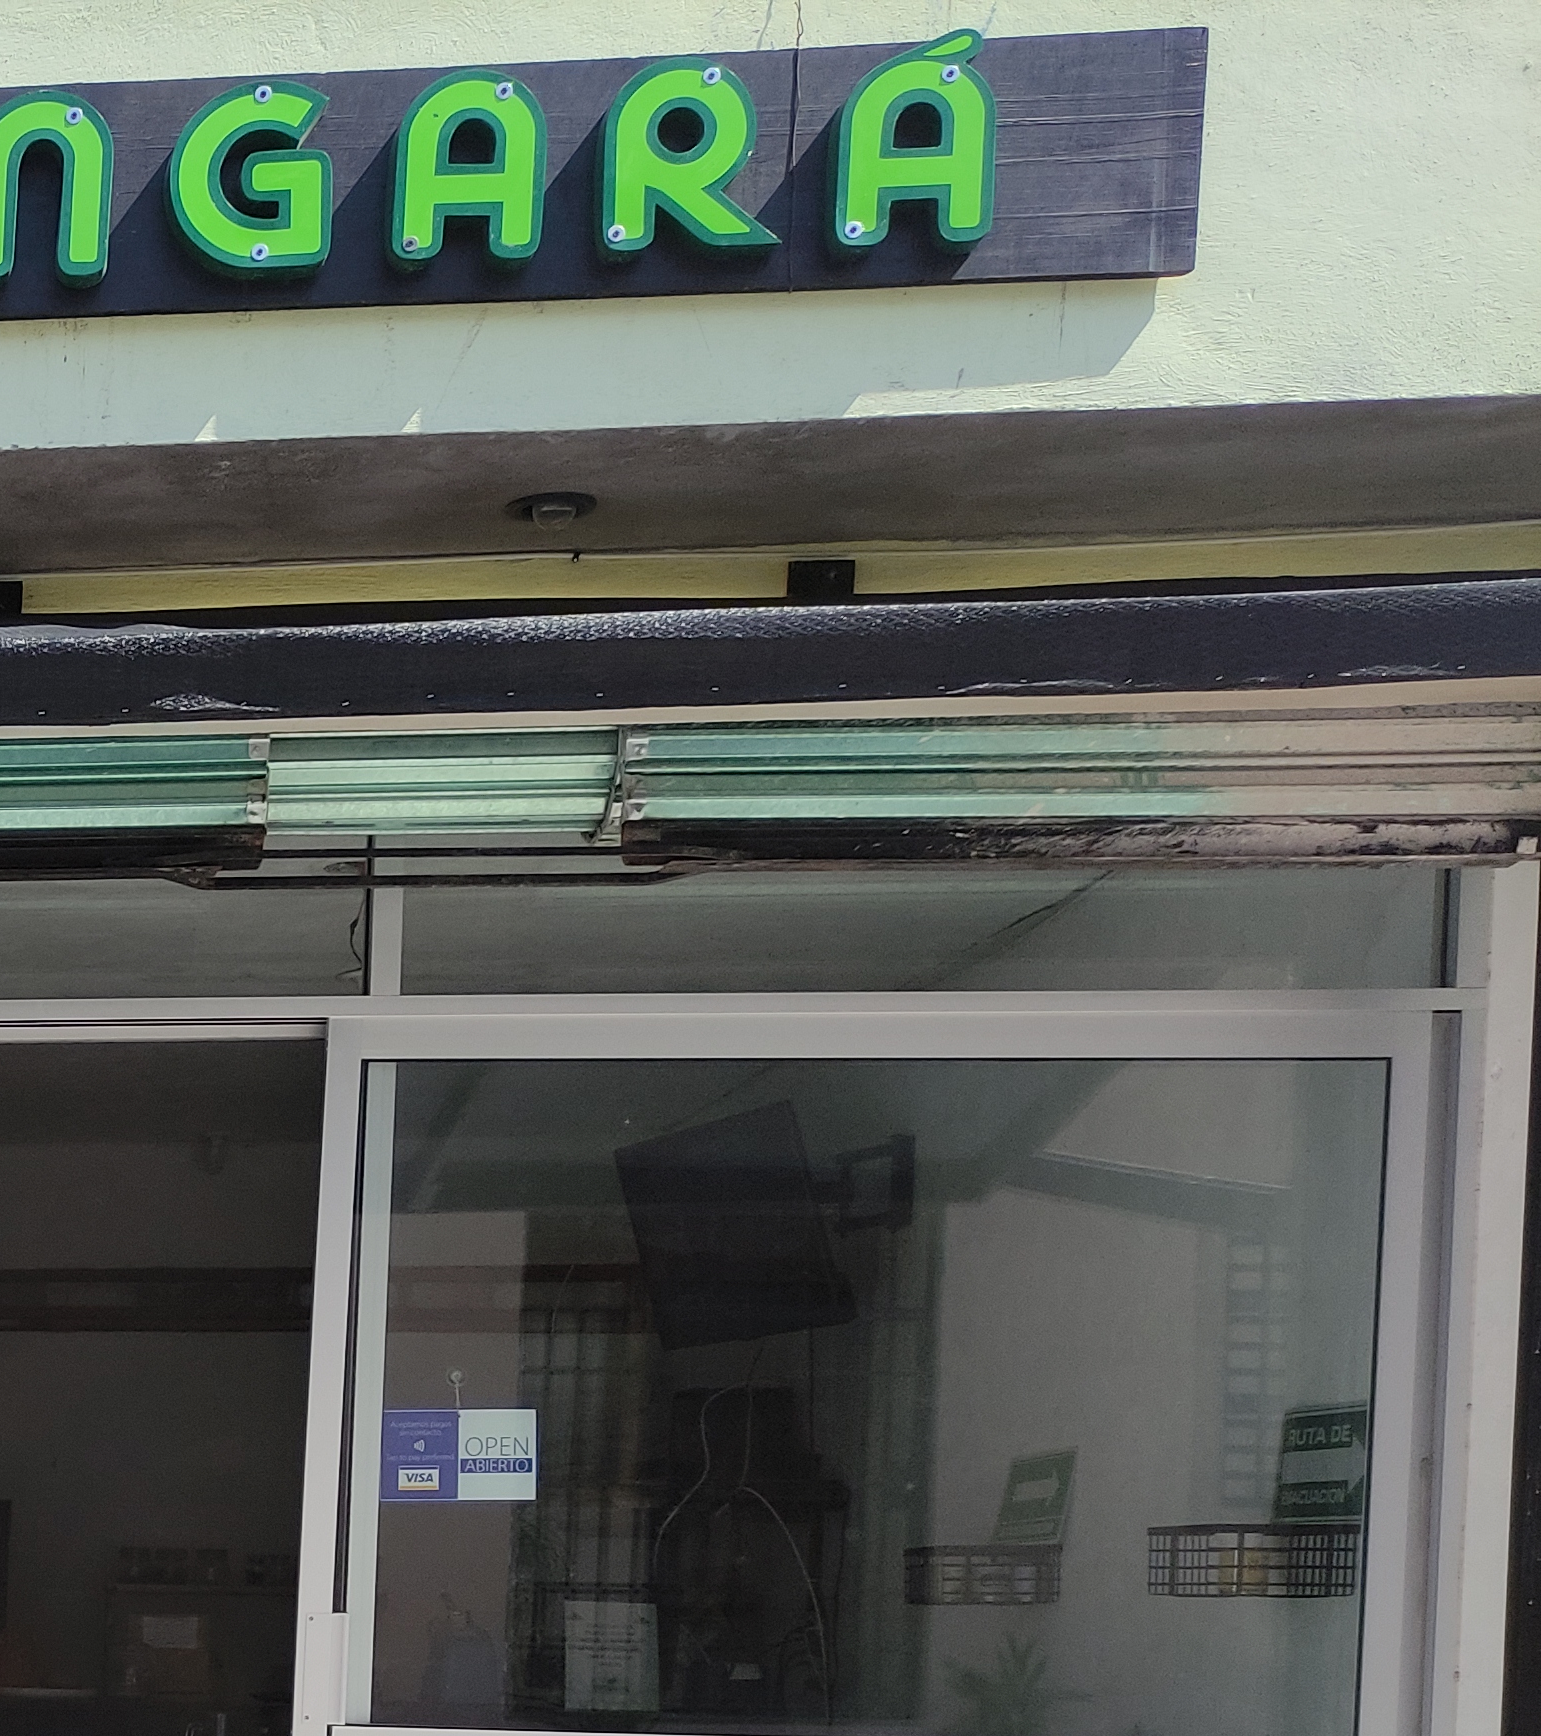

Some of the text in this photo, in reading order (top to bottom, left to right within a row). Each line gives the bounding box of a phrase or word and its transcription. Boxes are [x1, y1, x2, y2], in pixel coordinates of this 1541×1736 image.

[465, 1437, 529, 1456] OPEN
[464, 1459, 528, 1472] ABIERTO
[404, 1473, 433, 1482] VISA
